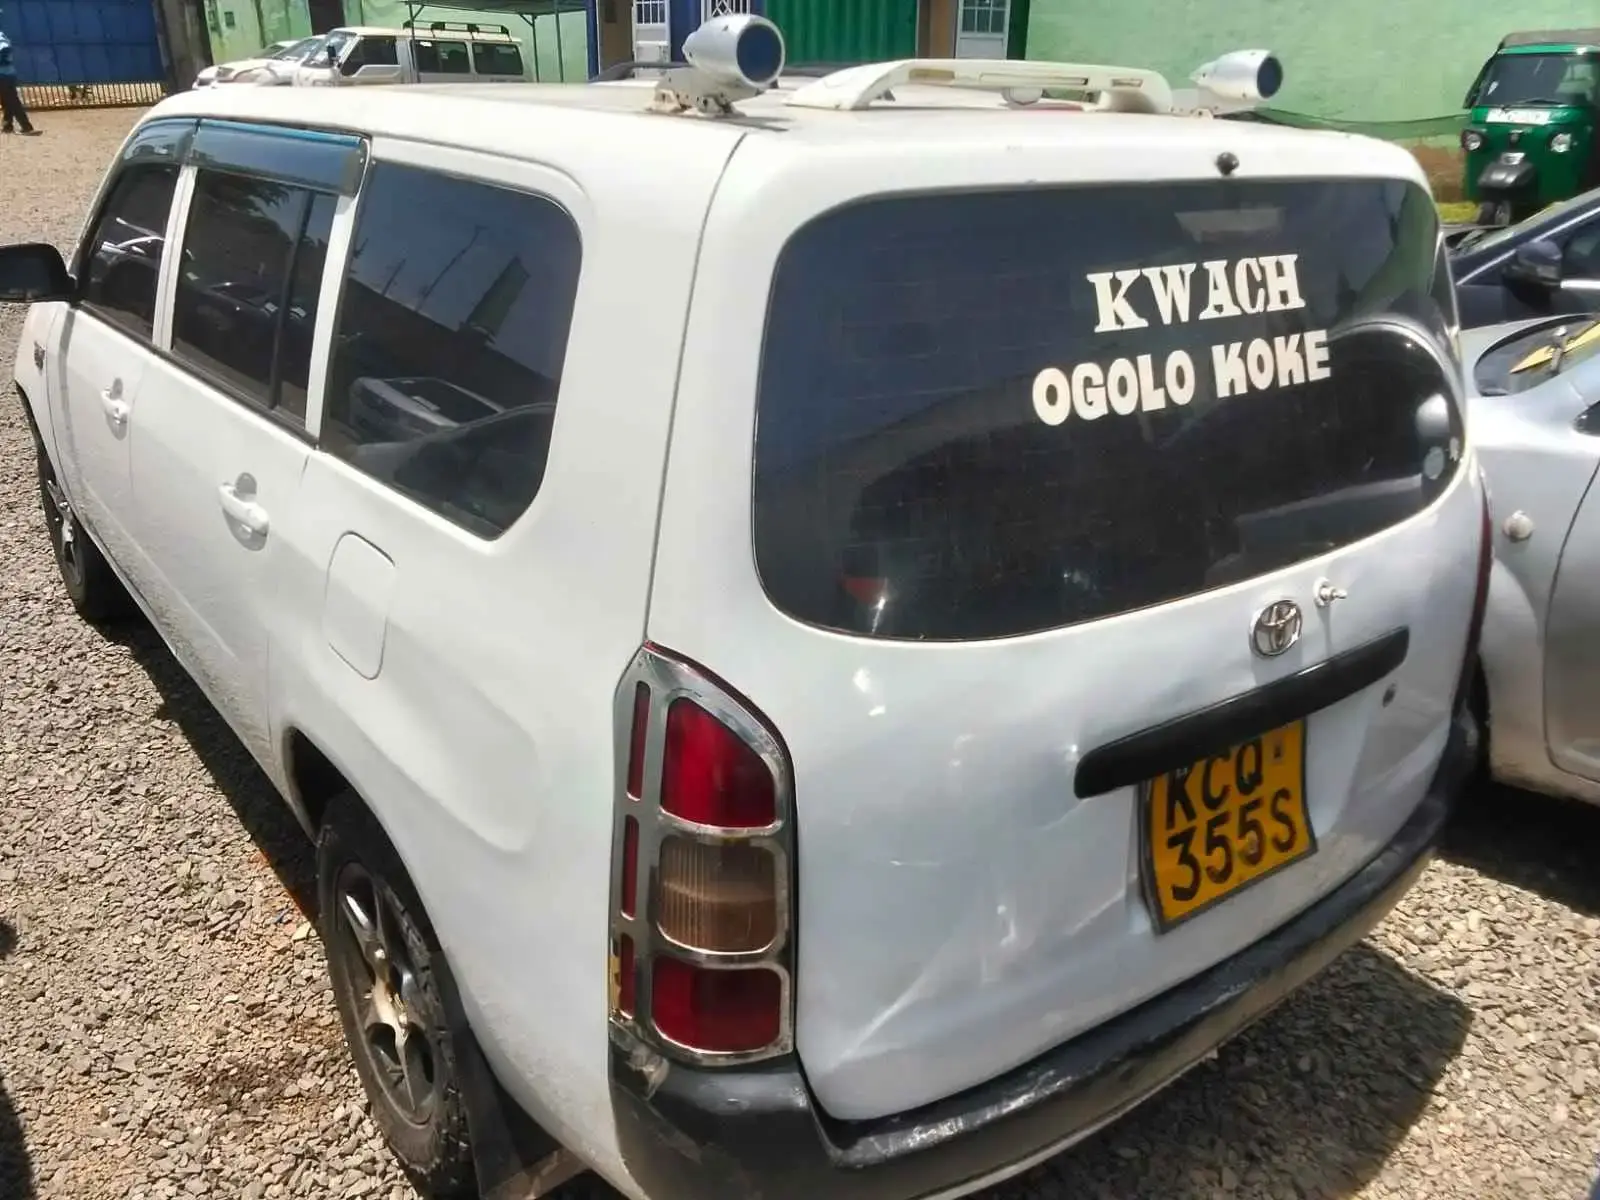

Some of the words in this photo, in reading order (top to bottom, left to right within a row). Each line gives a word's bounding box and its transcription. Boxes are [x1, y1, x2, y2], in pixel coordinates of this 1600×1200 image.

[1086, 254, 1305, 333] KWACH
[1032, 350, 1195, 426] OGOLO
[1212, 329, 1331, 398] KOKE
[1166, 738, 1263, 830] KCQ
[1167, 788, 1297, 901] 355S
